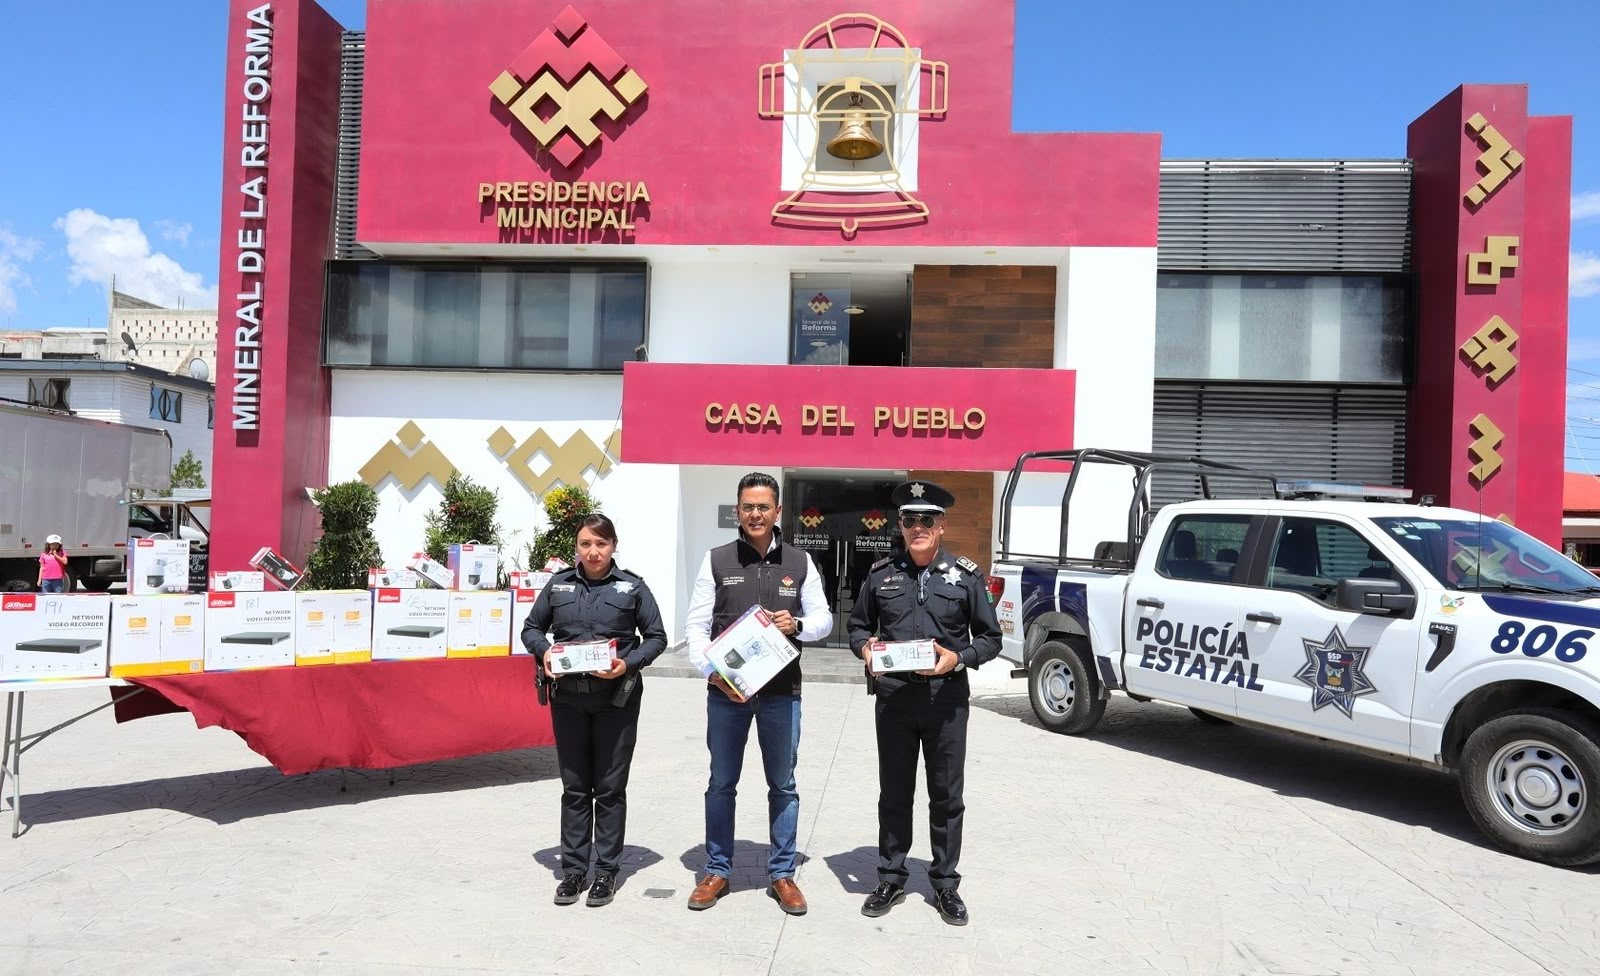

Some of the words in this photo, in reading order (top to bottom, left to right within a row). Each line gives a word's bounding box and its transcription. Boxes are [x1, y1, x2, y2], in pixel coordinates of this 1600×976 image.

[241, 3, 272, 167] REFORMA
[240, 175, 265, 218] LA
[478, 181, 650, 203] PRESIDENCIA
[497, 207, 635, 229] MUNICIPAL
[237, 228, 264, 273] DE
[232, 282, 263, 430] MINERAL
[705, 402, 782, 426] CASA
[801, 404, 856, 428] DEL
[873, 407, 986, 430] PUEBLO
[855, 540, 891, 548] Reforma
[1136, 617, 1250, 660] POLICÍA
[1327, 652, 1342, 660] SSP
[1490, 620, 1596, 663] 806
[1139, 644, 1265, 692] ESTATAL
